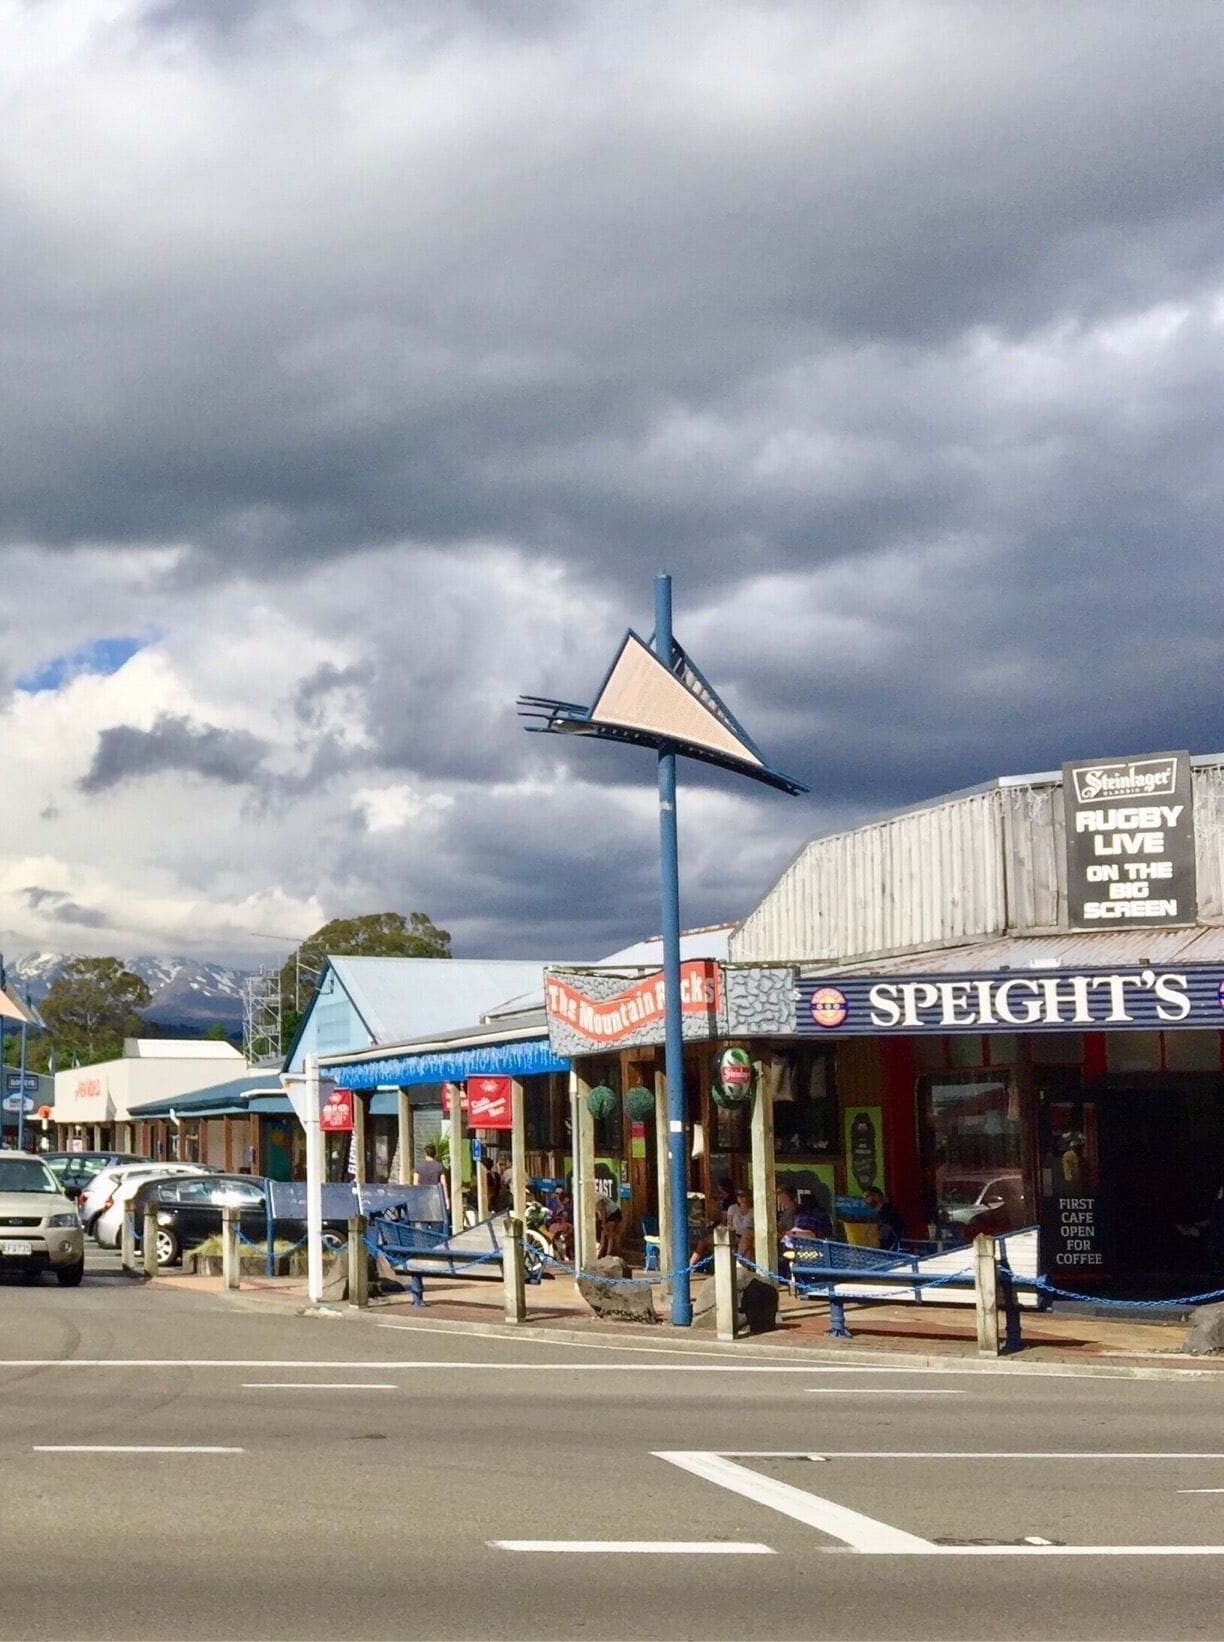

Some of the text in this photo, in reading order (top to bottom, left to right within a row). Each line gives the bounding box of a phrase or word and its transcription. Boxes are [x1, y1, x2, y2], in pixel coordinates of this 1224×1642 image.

[1081, 766, 1172, 799] Steinlager
[1075, 805, 1184, 832] RUGBY
[1094, 832, 1164, 856] LIVE
[1086, 862, 1173, 882] ON THE
[1109, 881, 1149, 899] BIG
[1083, 899, 1177, 919] SCREEN
[548, 971, 715, 1035] The Mountain Rcks
[869, 970, 1192, 1027] SPEIGHT'S
[1059, 1198, 1095, 1209] FIRST
[1061, 1212, 1093, 1223] CAFE
[1060, 1226, 1095, 1237] OPEN
[1067, 1239, 1091, 1251] FOR
[1056, 1253, 1103, 1265] COFFEE
